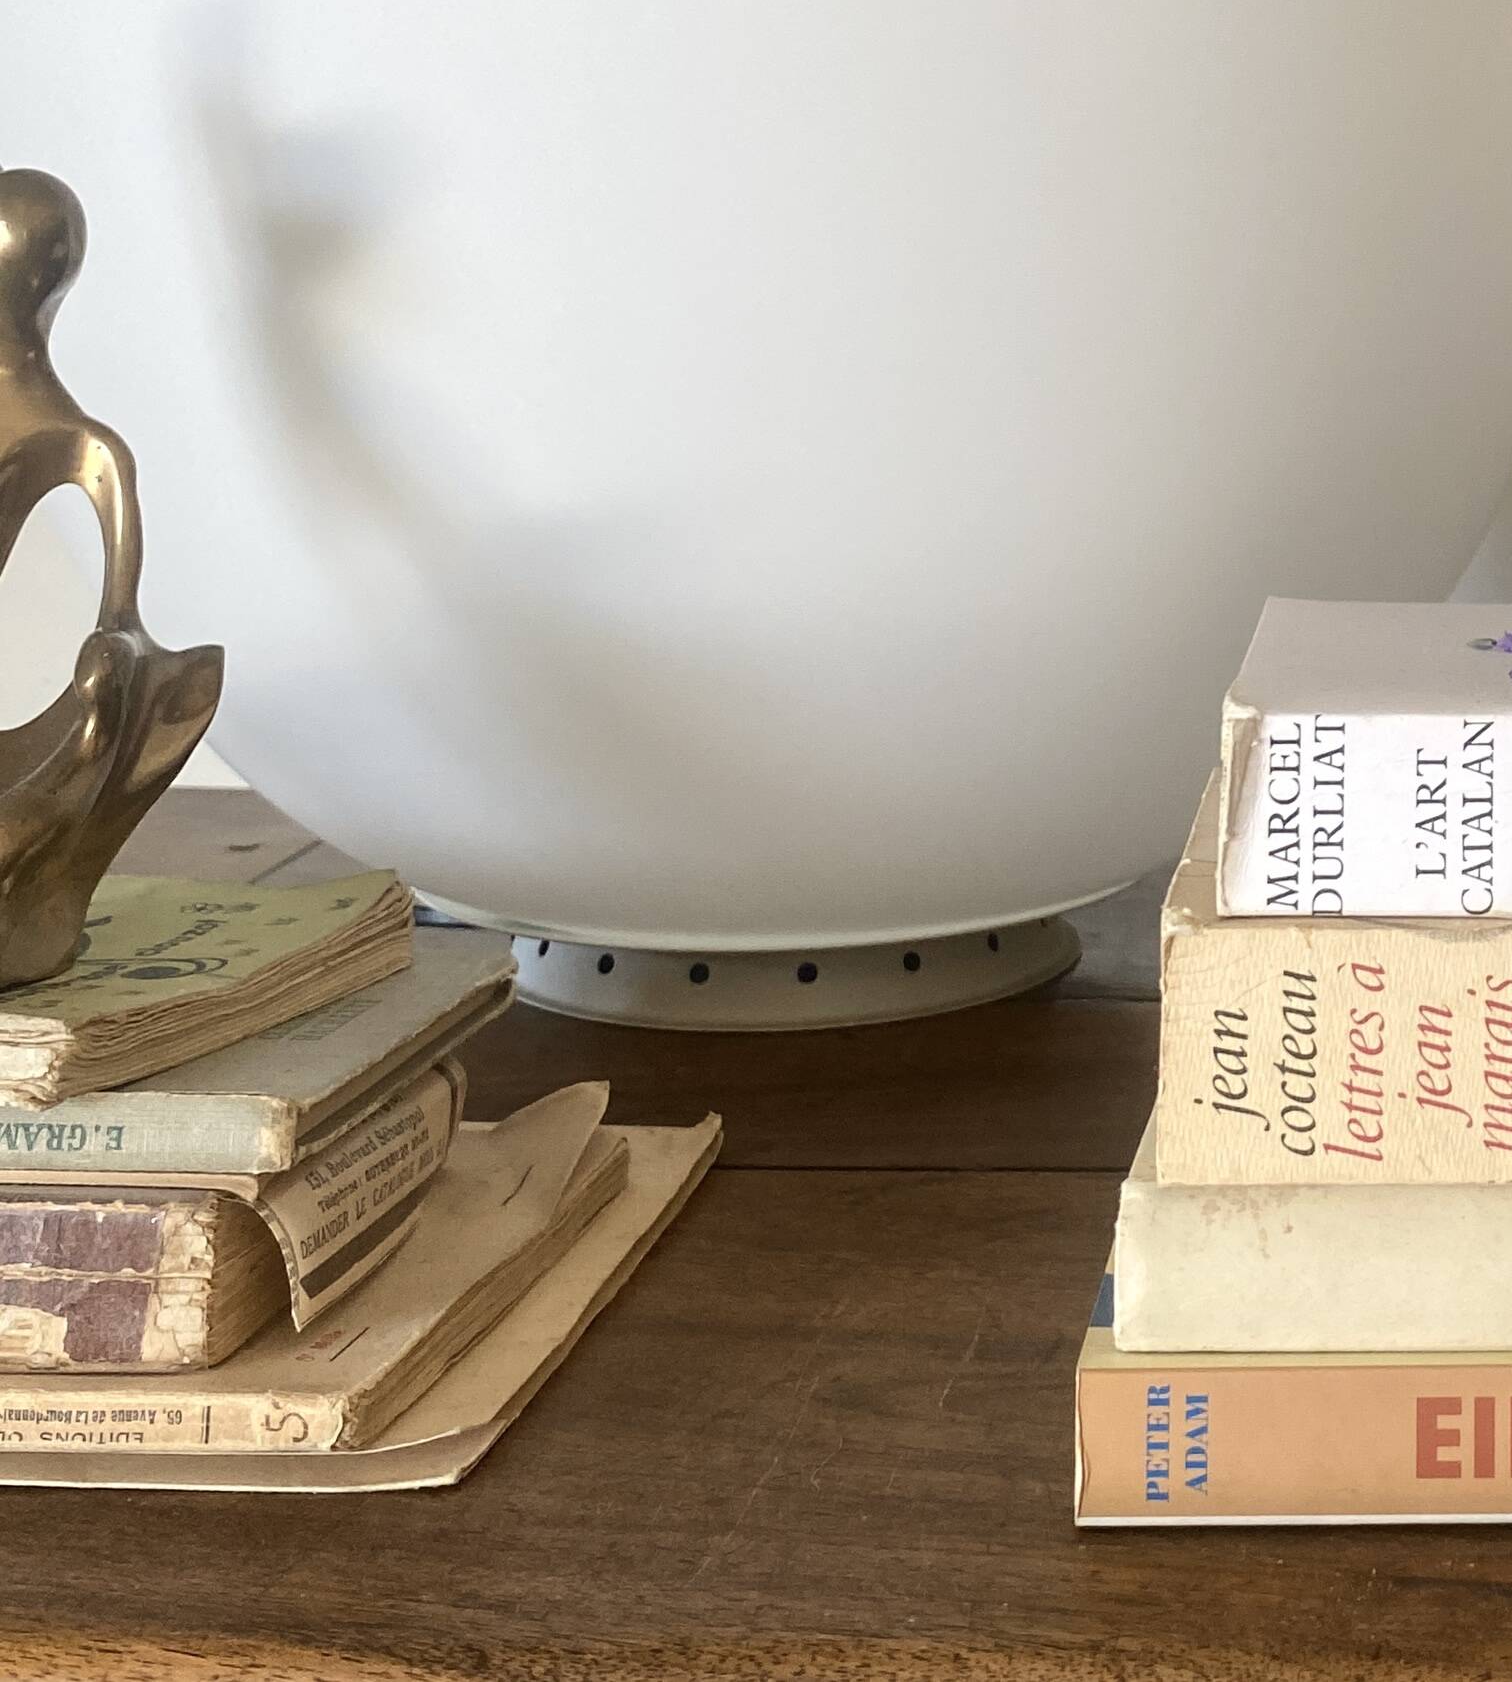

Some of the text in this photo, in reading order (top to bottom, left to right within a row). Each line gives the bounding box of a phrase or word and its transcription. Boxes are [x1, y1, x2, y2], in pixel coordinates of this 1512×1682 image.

[1266, 721, 1302, 911] MARCEL
[1311, 713, 1346, 917] DURLIAT
[1414, 747, 1448, 880] L'ART
[1460, 718, 1495, 916] CATALAN
[1192, 1007, 1271, 1132] jean
[1272, 969, 1318, 1157] cocteau
[1322, 957, 1386, 1162] lettres à
[1397, 1003, 1473, 1129] jean
[300, 1210, 350, 1260] DEMANDER
[356, 1196, 368, 1221] LE
[92, 1408, 107, 1425] de
[110, 1408, 157, 1425] Avenue
[1145, 1384, 1171, 1503] PETER
[1184, 1391, 1210, 1497] ADAM
